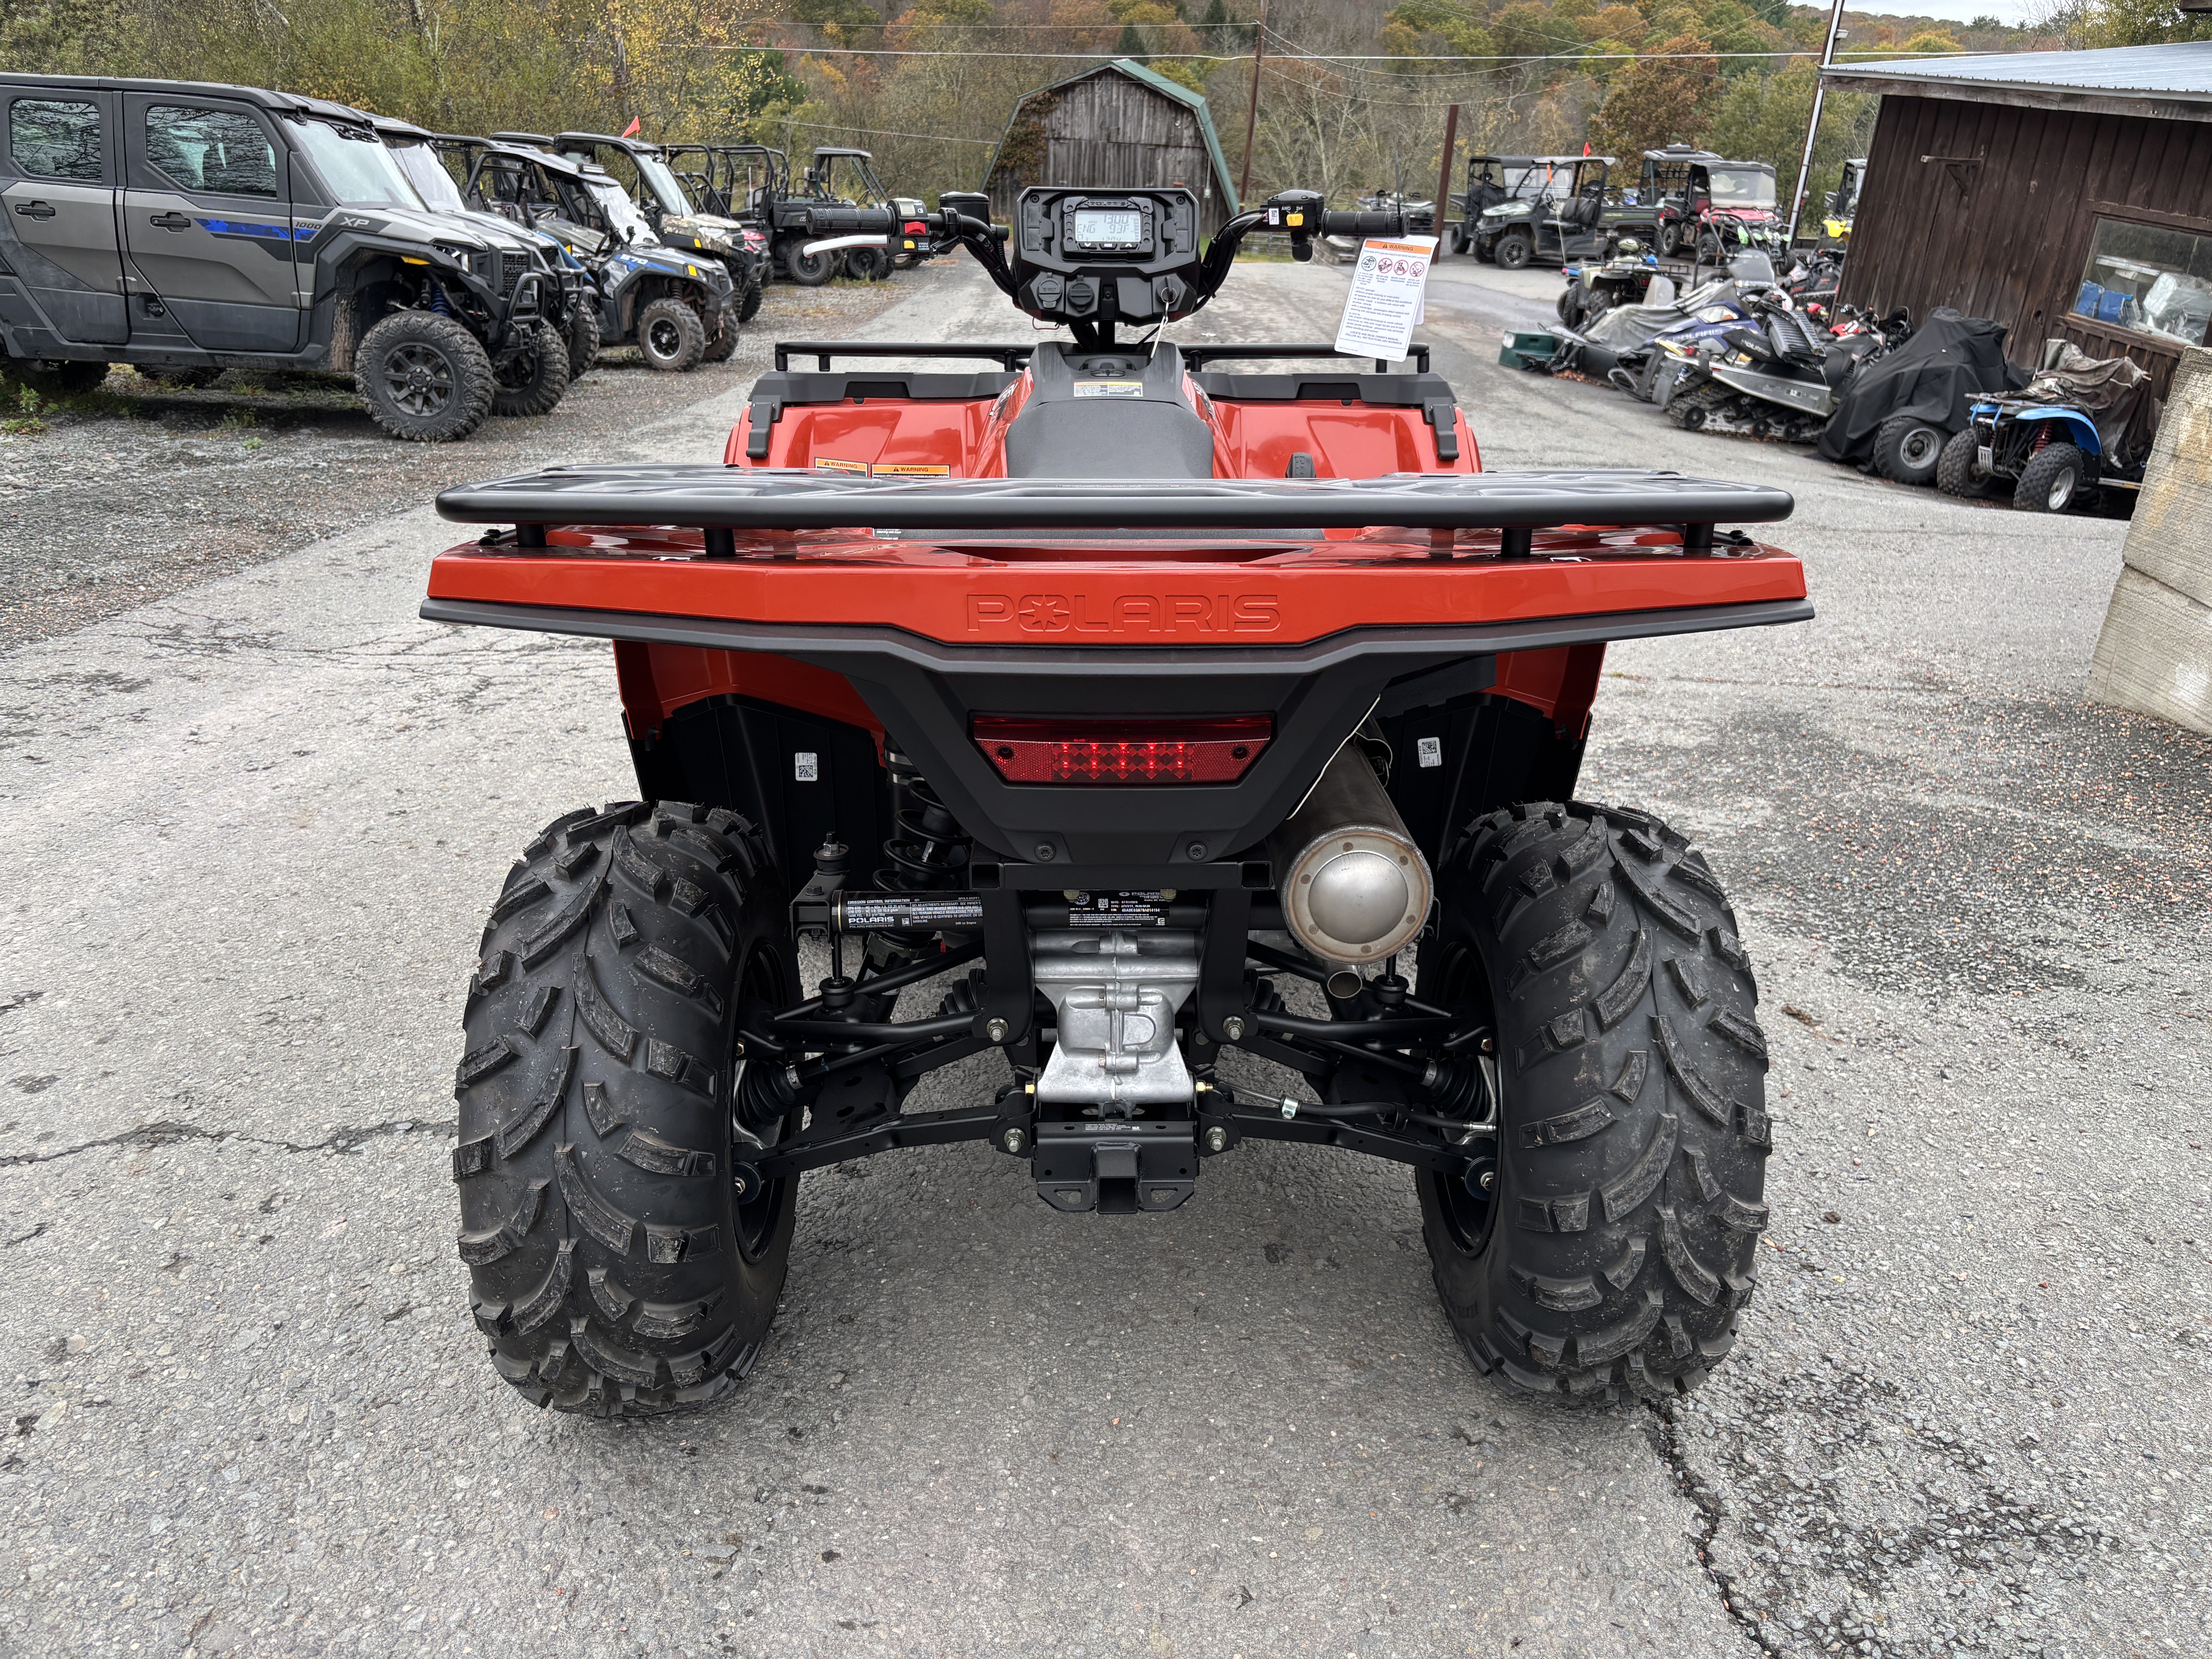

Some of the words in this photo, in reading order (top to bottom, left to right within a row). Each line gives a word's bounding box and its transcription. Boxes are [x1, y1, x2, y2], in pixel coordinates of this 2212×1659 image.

[339, 216, 370, 227] XP
[1104, 214, 1129, 224] 1300
[1077, 224, 1095, 233] ENG
[967, 594, 1281, 632] POLARIS
